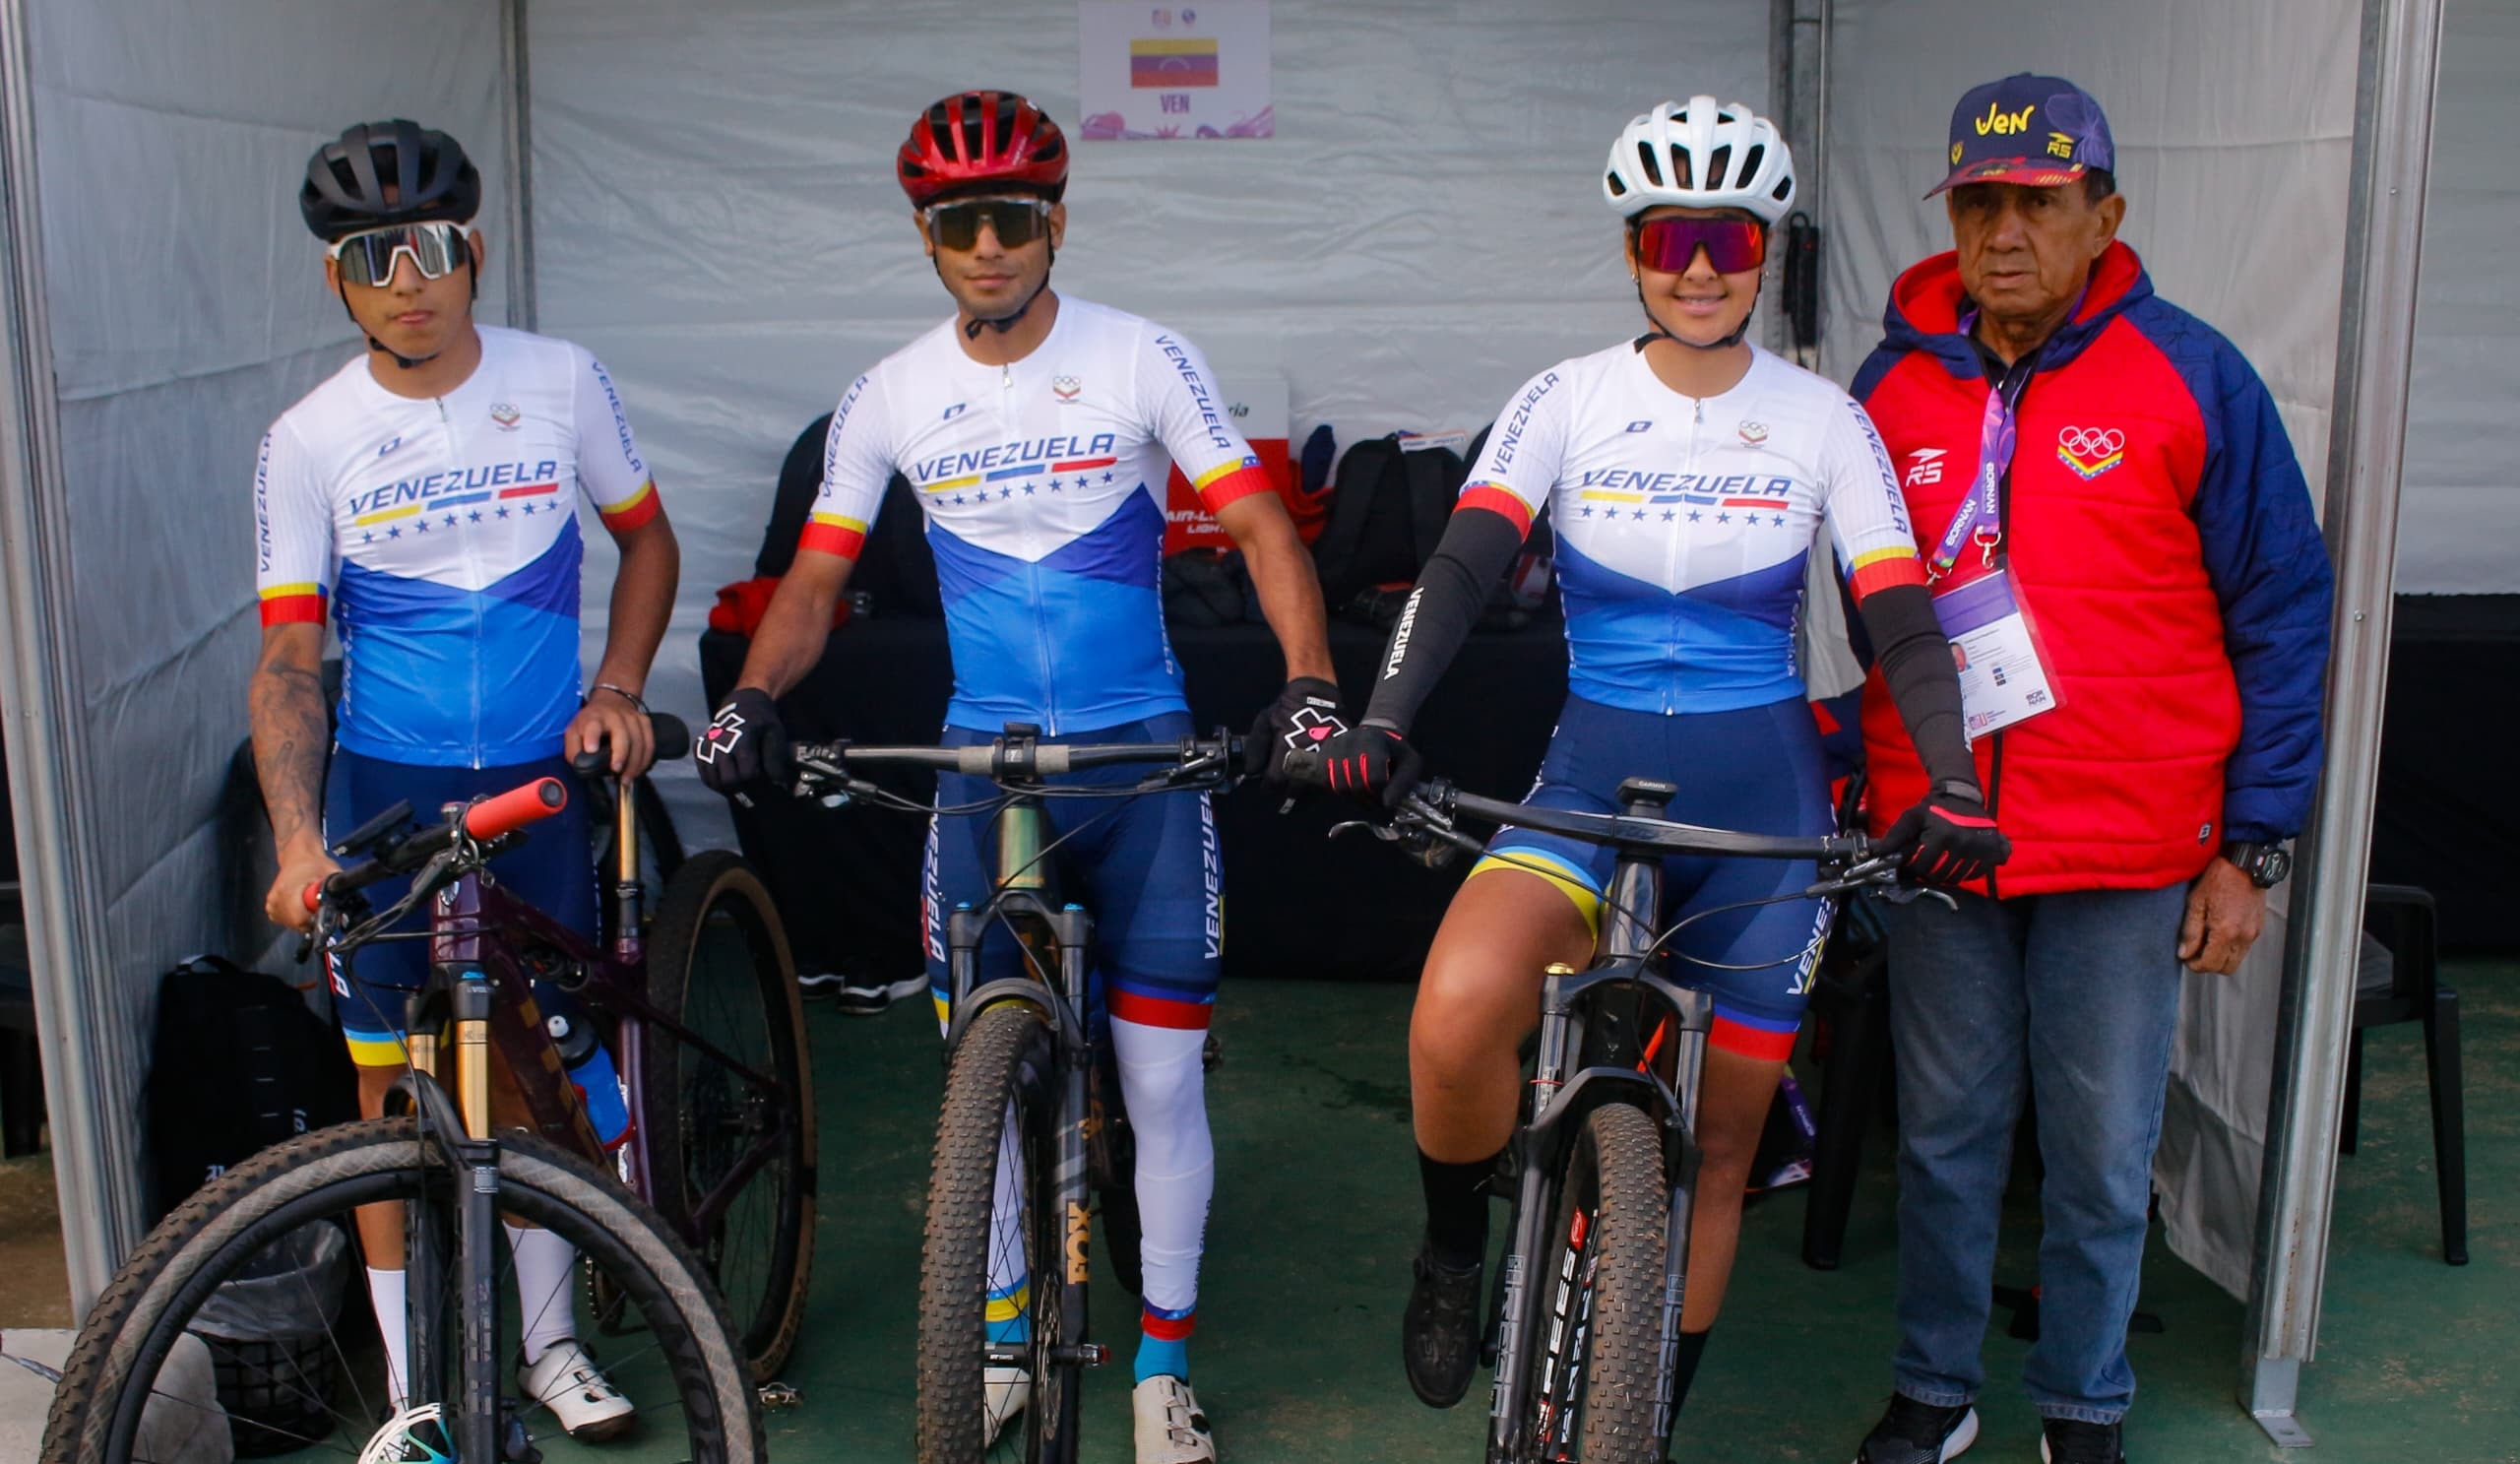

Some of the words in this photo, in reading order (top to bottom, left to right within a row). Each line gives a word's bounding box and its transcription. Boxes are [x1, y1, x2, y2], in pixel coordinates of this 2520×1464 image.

[1160, 95, 1190, 113] VEN
[592, 361, 642, 473] VENEZUELA
[1156, 334, 1231, 449] VENEZUELA
[1490, 371, 1559, 475] VENEZUELA
[349, 461, 557, 515] VENEZUELA
[917, 433, 1115, 481] VENEZUELA
[1582, 469, 1793, 497] VENEZUELA
[1847, 401, 1908, 535] VENEZUELA
[1906, 461, 1944, 487] RS
[1985, 462, 1995, 514] BORNAN
[1945, 498, 1977, 546] BORNAN
[1384, 587, 1424, 680] VENEZUELA
[1200, 790, 1220, 959] VENEZUEL
[1065, 1201, 1090, 1285] FOX
